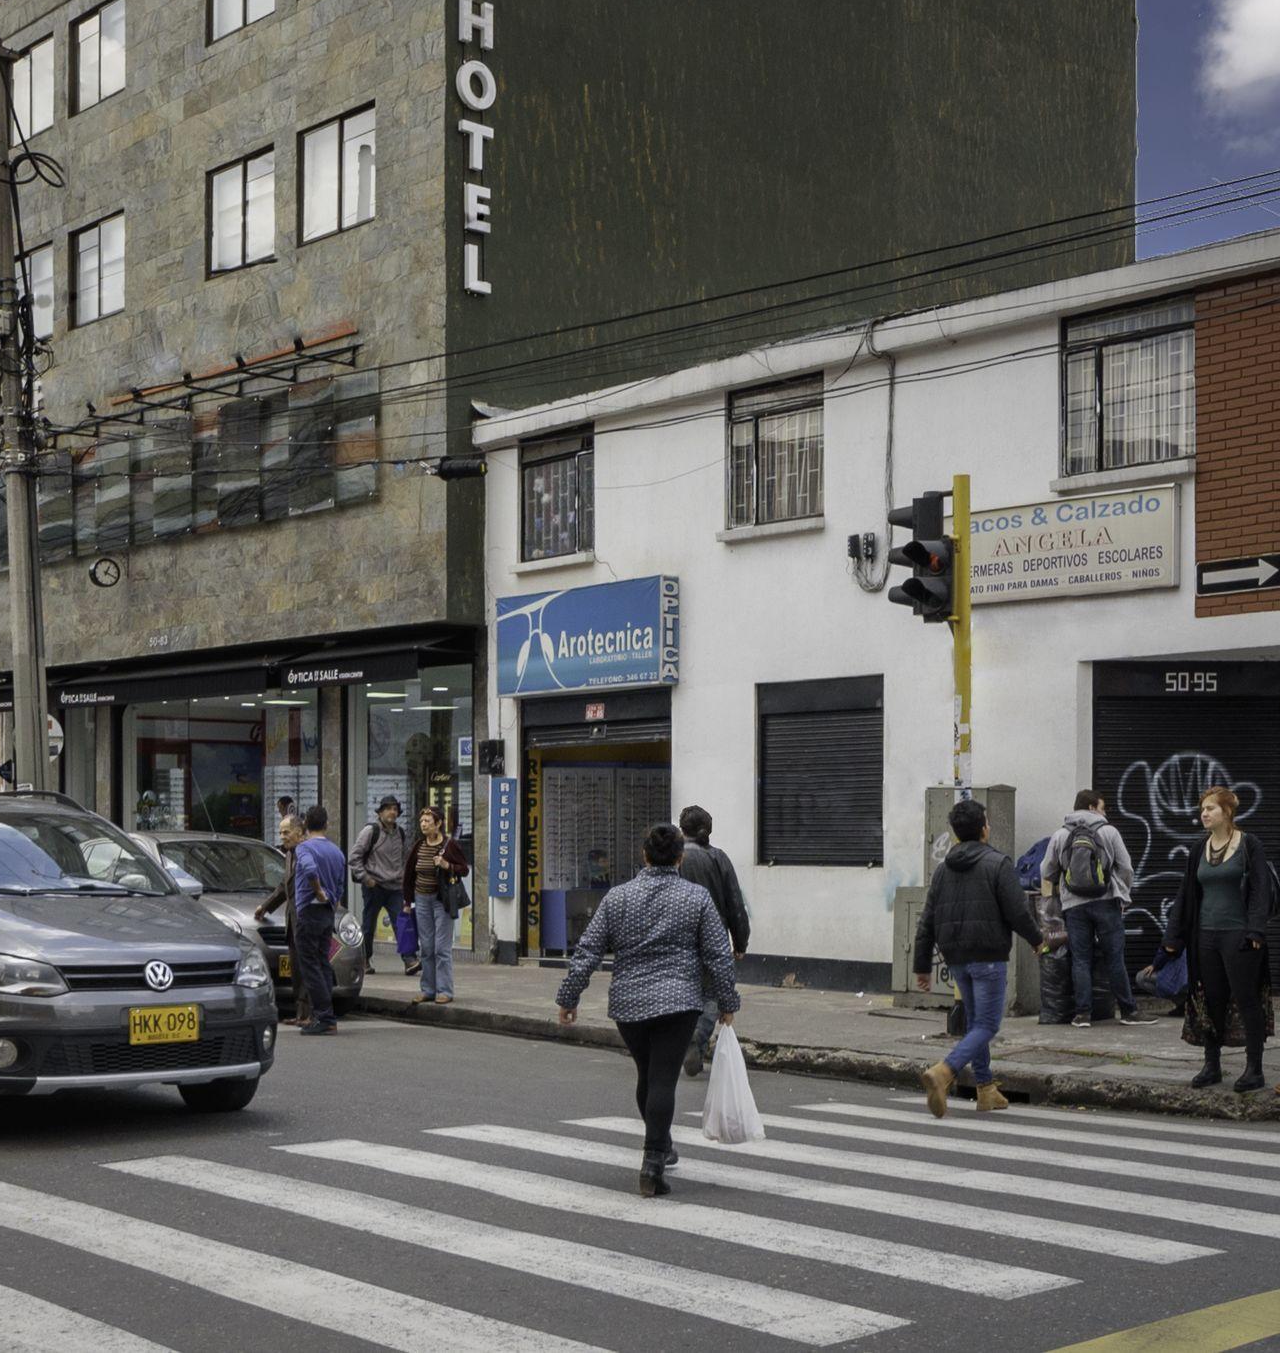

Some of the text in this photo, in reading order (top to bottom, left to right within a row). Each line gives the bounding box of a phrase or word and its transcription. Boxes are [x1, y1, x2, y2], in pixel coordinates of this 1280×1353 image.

[970, 494, 1161, 534] acos & Calzado
[991, 526, 1114, 557] ANGELA
[1023, 553, 1088, 573] DEPORTIVOS
[1098, 545, 1163, 565] ESCOLARES
[986, 582, 1005, 593] FINO
[1007, 580, 1028, 591] PARA
[1030, 577, 1059, 588] DAMAS
[1068, 571, 1122, 585] CABALLEROS
[558, 622, 653, 658] Arotecnica
[663, 580, 679, 679] OPTICA
[498, 782, 510, 893] REPUESTOS
[528, 758, 539, 926] REPUESTOS
[133, 1012, 197, 1035] HKK 098
